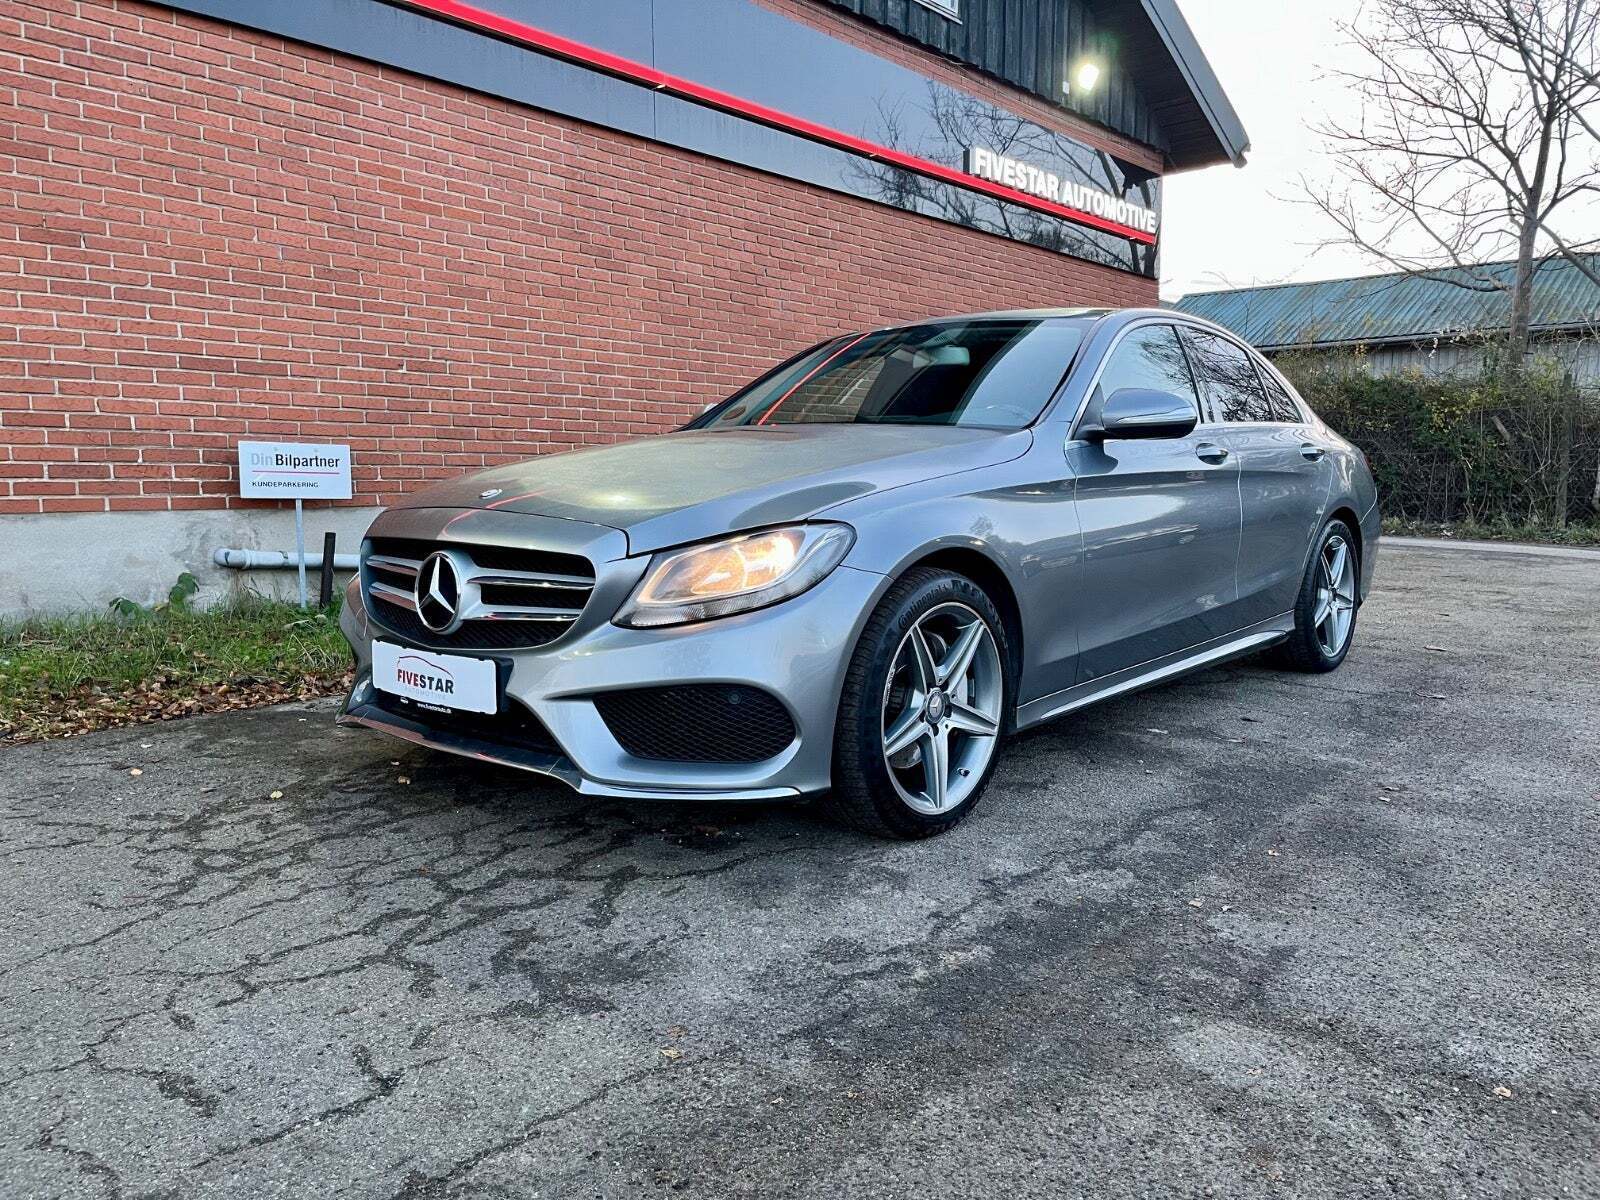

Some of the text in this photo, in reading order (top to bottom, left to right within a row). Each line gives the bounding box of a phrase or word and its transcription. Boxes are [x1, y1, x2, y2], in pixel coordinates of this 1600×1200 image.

[974, 147, 1157, 234] FIVESTAR AUTOMOTIVE
[397, 668, 454, 694] FIVESTAR
